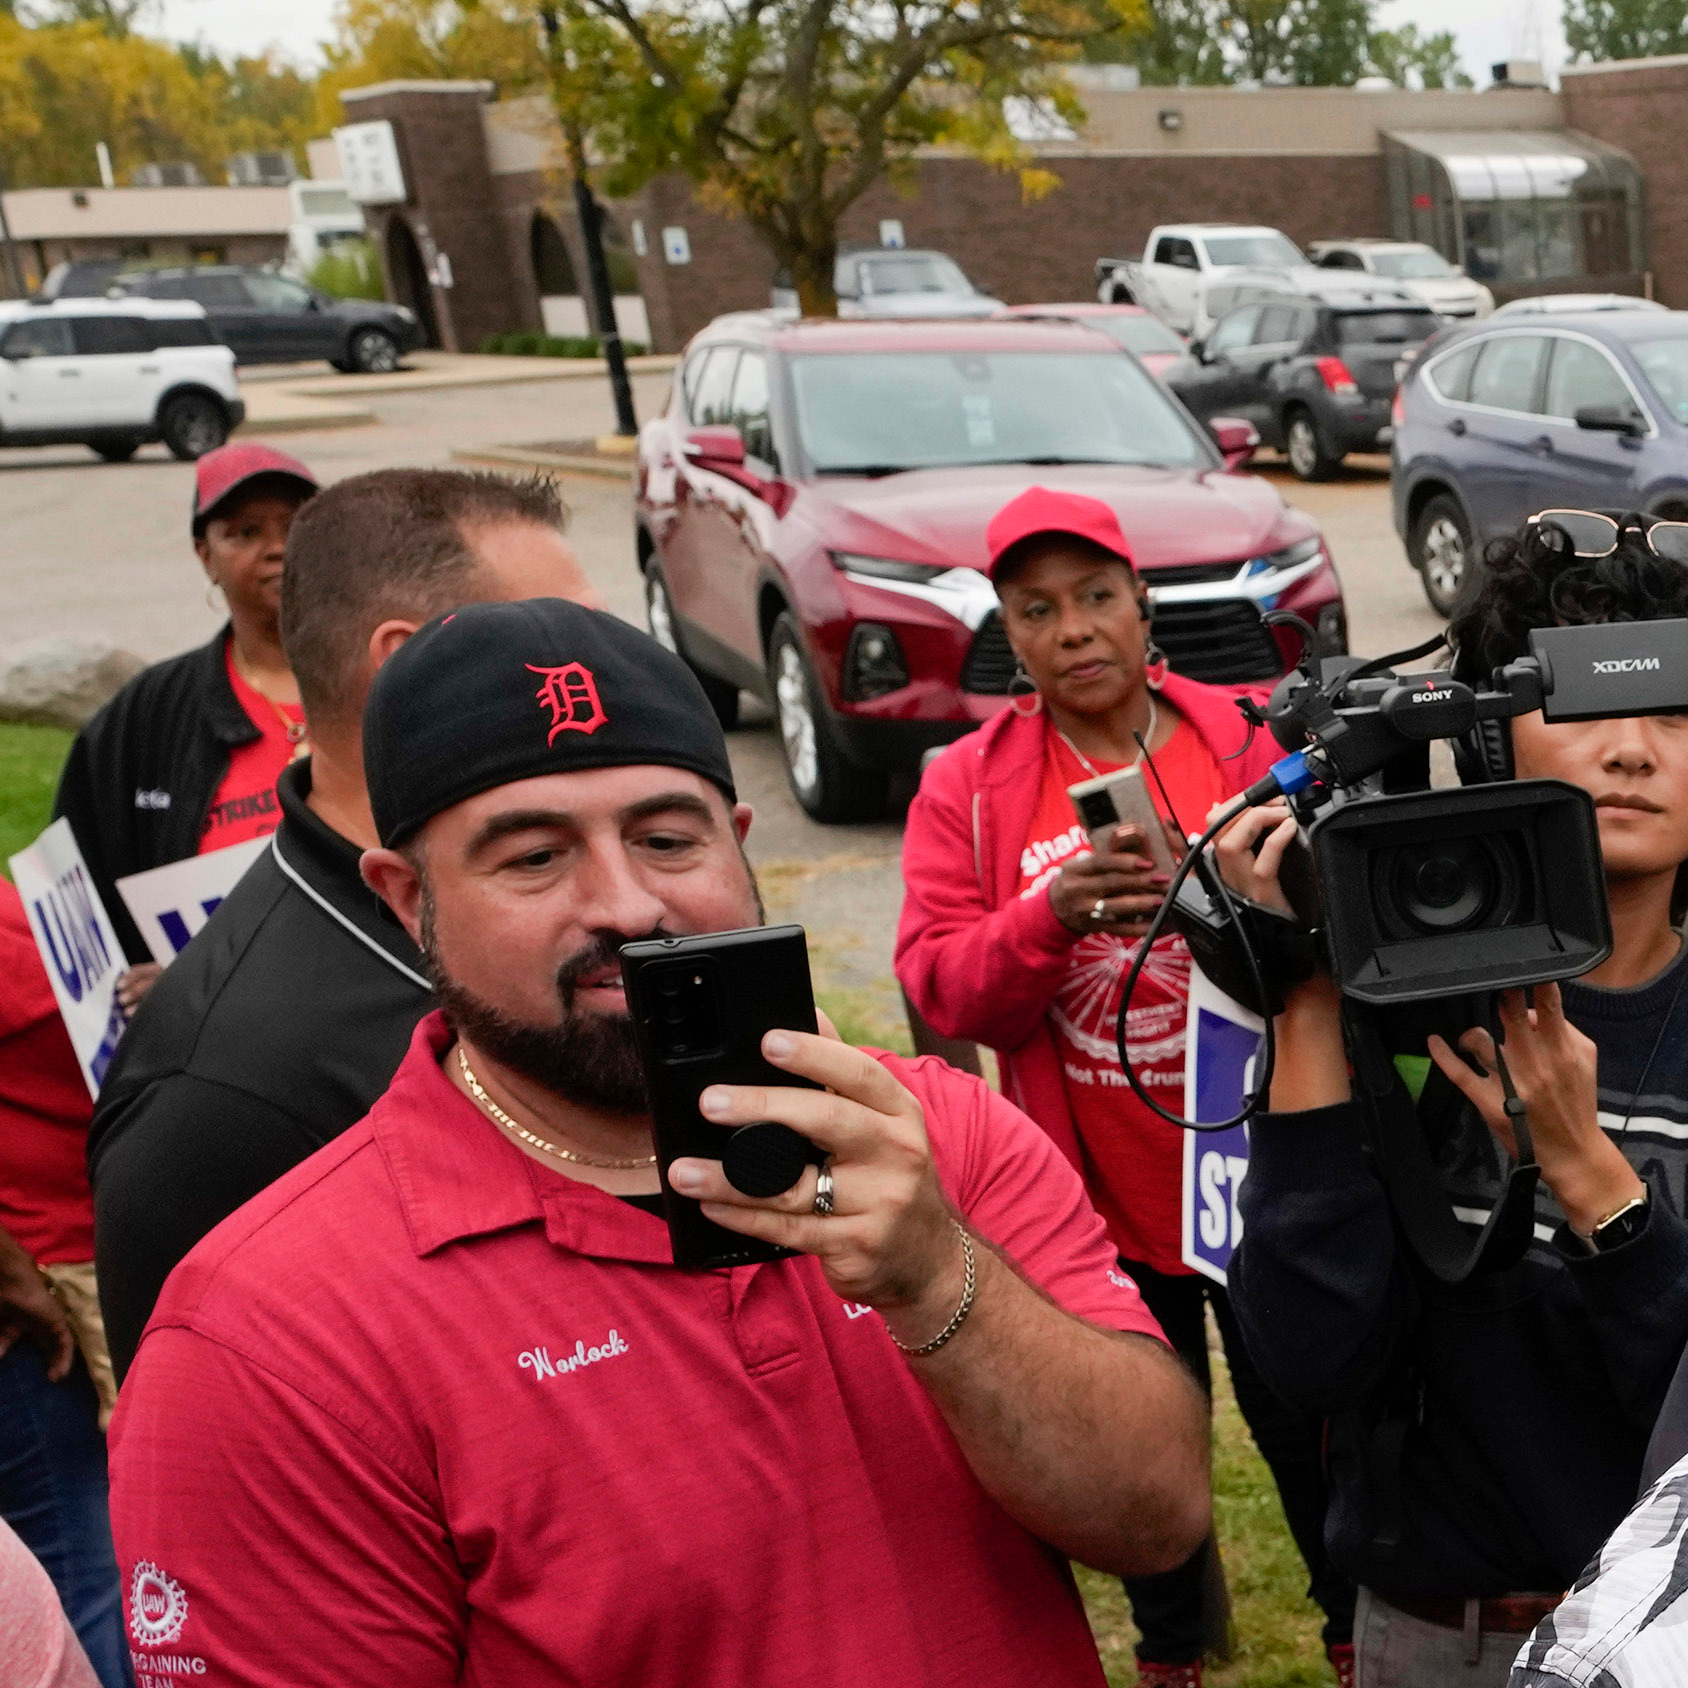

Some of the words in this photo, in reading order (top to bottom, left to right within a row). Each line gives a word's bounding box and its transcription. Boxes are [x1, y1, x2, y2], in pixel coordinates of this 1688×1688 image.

[1592, 657, 1660, 674] XDCAM
[1412, 689, 1453, 703] SONY
[212, 788, 278, 829] TRIKE
[33, 862, 112, 1003] UAW
[517, 1328, 629, 1381] Worlock
[143, 1593, 166, 1614] UAW
